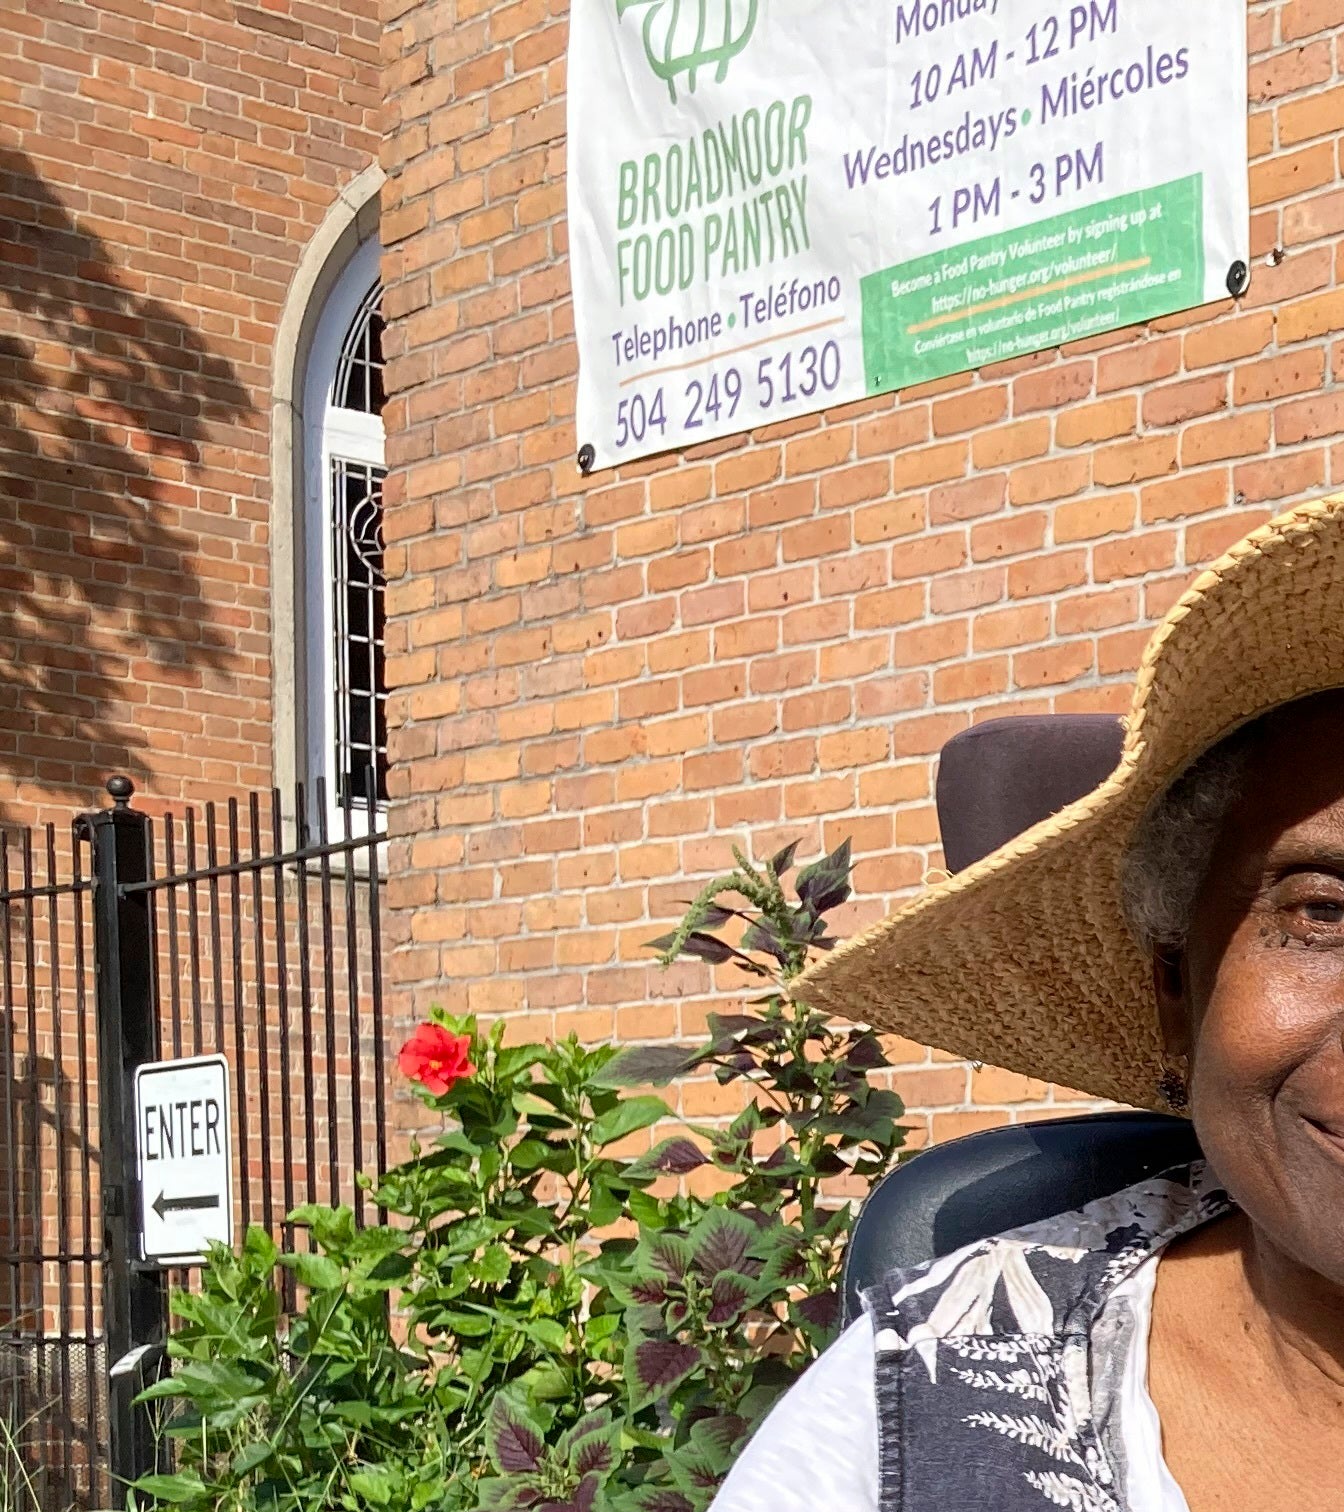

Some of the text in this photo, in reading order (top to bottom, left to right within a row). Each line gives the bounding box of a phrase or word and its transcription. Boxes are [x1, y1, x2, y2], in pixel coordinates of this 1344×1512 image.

[908, 63, 942, 110] 10
[946, 40, 999, 95] AM
[1025, 16, 1060, 66] 12
[1069, 0, 1119, 49] PM
[617, 94, 813, 231] BROADMOOR
[843, 45, 1190, 190] Wednesdays Miércoles
[928, 196, 942, 236] 1
[952, 176, 1001, 229] PM
[1029, 163, 1046, 205] 3
[1055, 141, 1104, 197] PM
[617, 174, 811, 308] FOOD PANTRY
[891, 202, 1162, 298] Become a Food Pantry Volunteer by signing up at
[612, 275, 841, 368] Telephone Teléfono
[1024, 306, 1037, 322] de
[1038, 299, 1063, 317] Food
[1063, 292, 1096, 313] Pantry
[615, 340, 841, 448] 504 249 5130
[145, 1098, 220, 1160] ENTER
